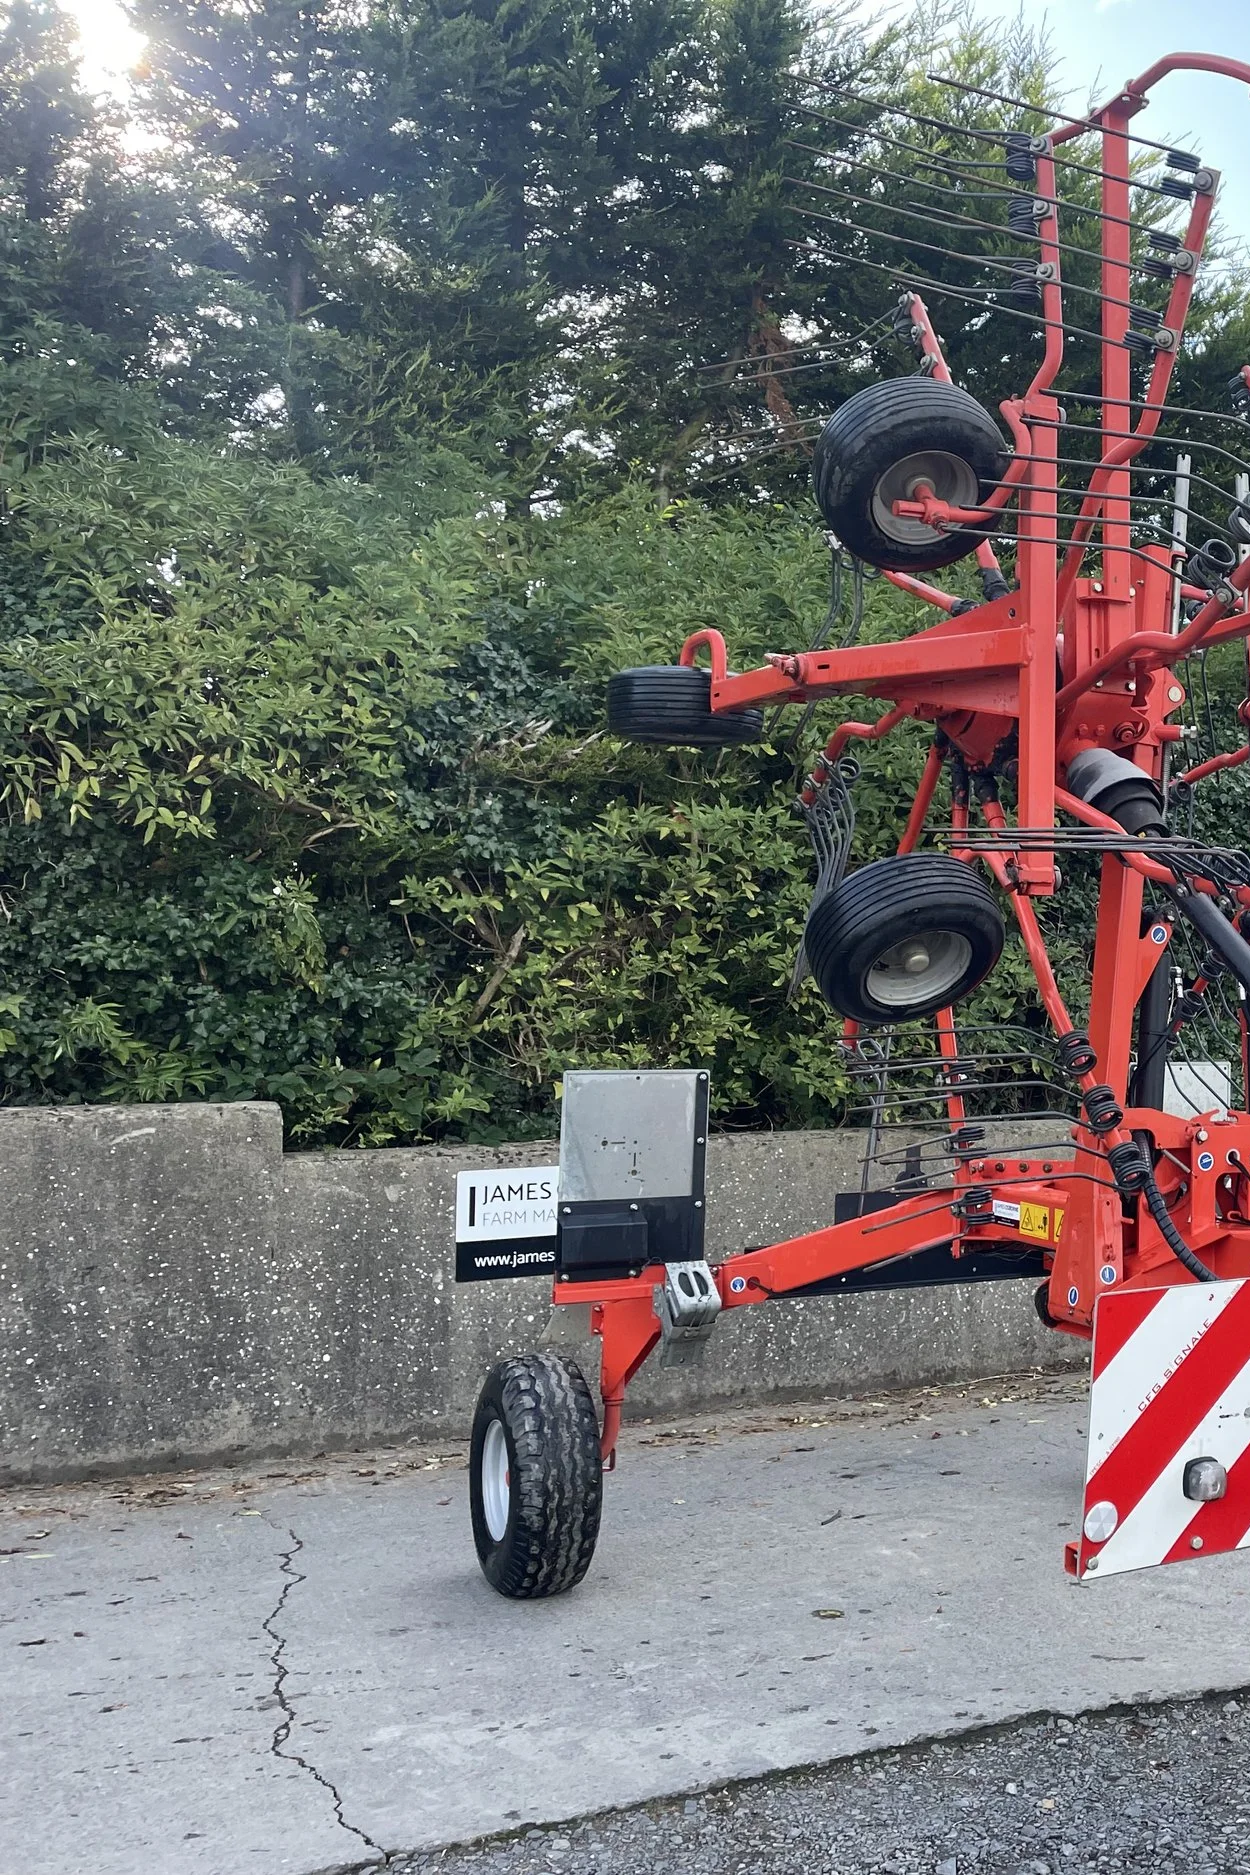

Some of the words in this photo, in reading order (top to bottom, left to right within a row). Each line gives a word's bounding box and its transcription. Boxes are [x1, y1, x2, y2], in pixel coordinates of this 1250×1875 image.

[482, 1182, 552, 1205] JAMES
[482, 1210, 527, 1226] FARM
[474, 1251, 556, 1268] www.james
[1137, 1382, 1162, 1412] CFG
[1163, 1318, 1212, 1379] SGNALE
